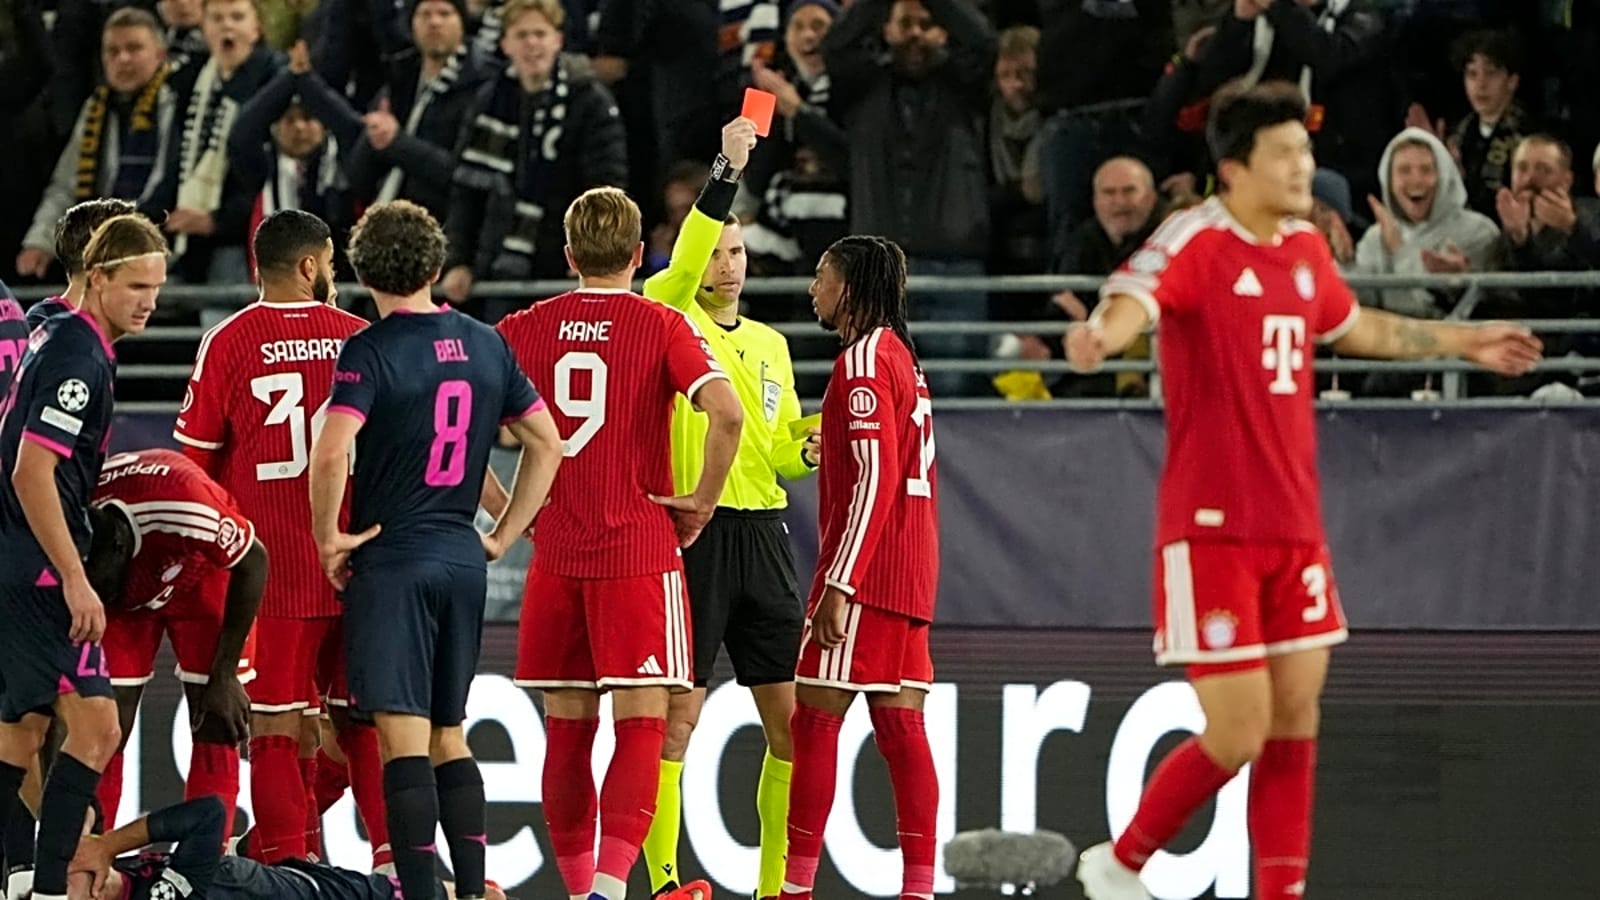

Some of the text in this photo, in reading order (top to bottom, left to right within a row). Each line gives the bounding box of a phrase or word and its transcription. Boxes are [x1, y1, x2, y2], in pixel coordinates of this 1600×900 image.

[260, 338, 341, 364] SAIBARI
[433, 338, 469, 362] BELL
[558, 320, 612, 341] KANE
[554, 351, 607, 457] 9
[425, 380, 472, 487] 8
[1301, 563, 1328, 623] 3
